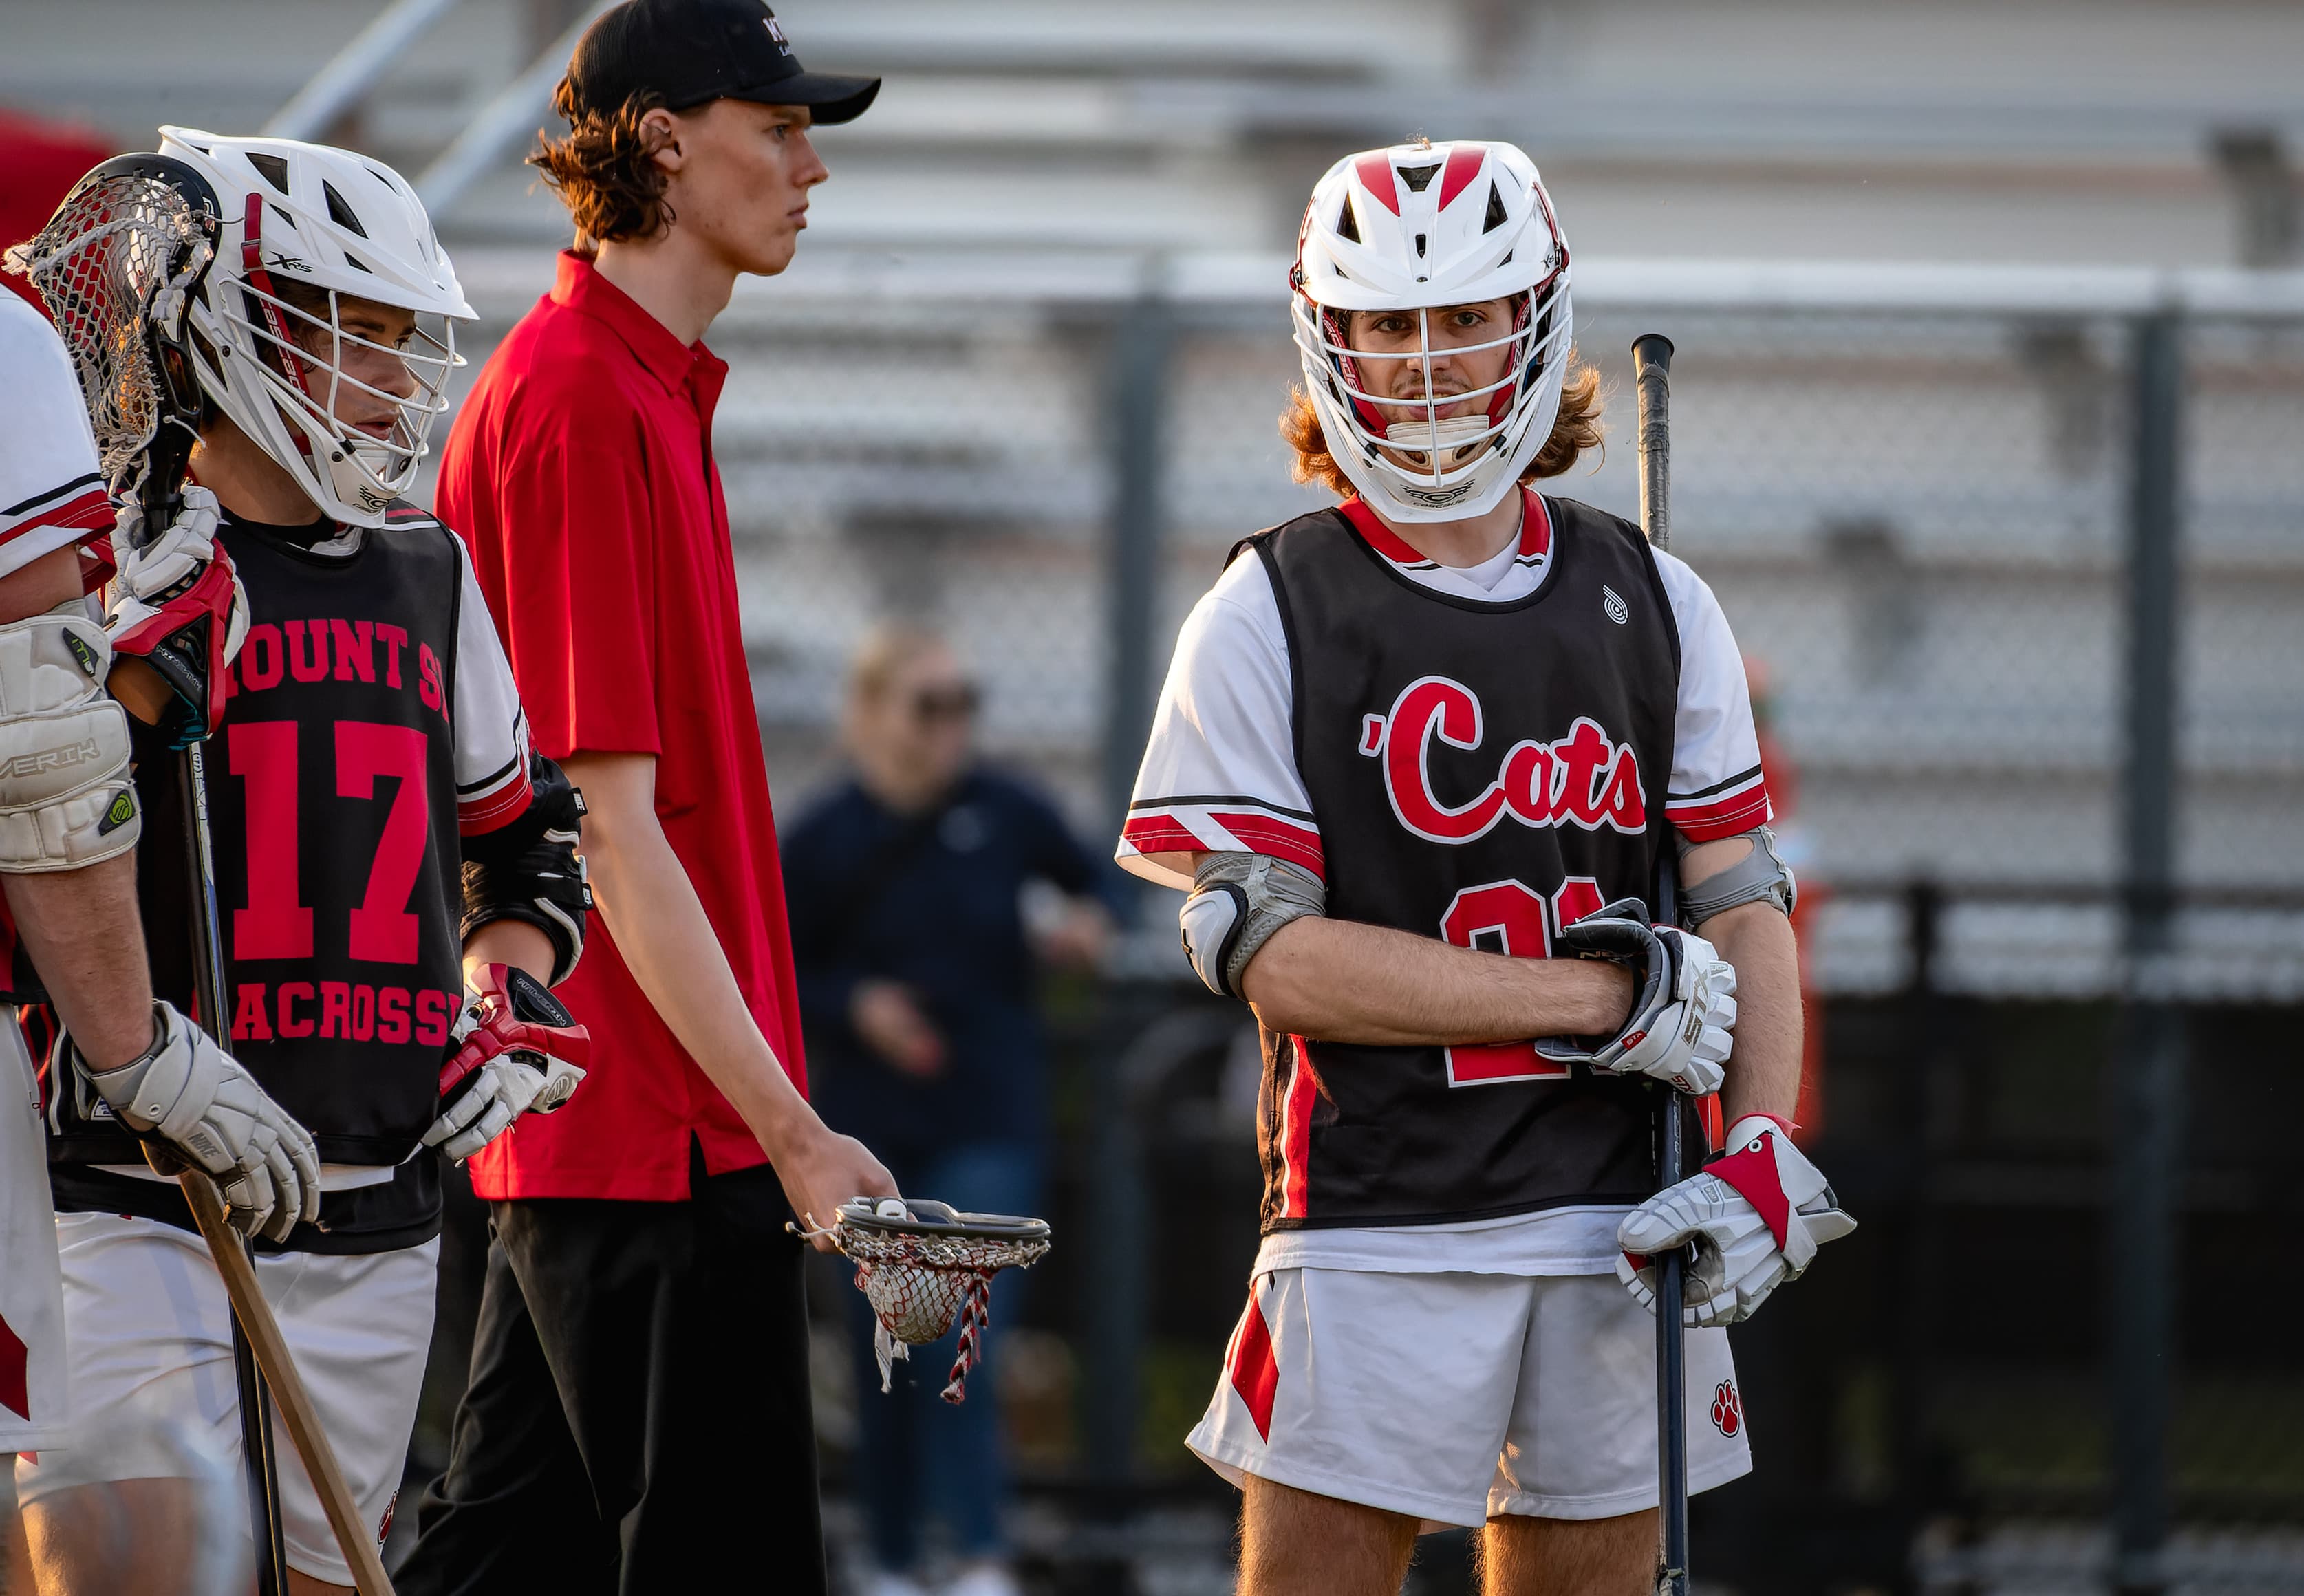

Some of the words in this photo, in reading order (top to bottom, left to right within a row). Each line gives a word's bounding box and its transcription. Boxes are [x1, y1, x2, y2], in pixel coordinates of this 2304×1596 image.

[265, 250, 314, 272] XRS
[224, 618, 408, 699] OUNT
[228, 720, 428, 964] 17
[191, 981, 462, 1046] ACROSS
[1683, 960, 1708, 1050] STX
[188, 1132, 221, 1159] NIKE
